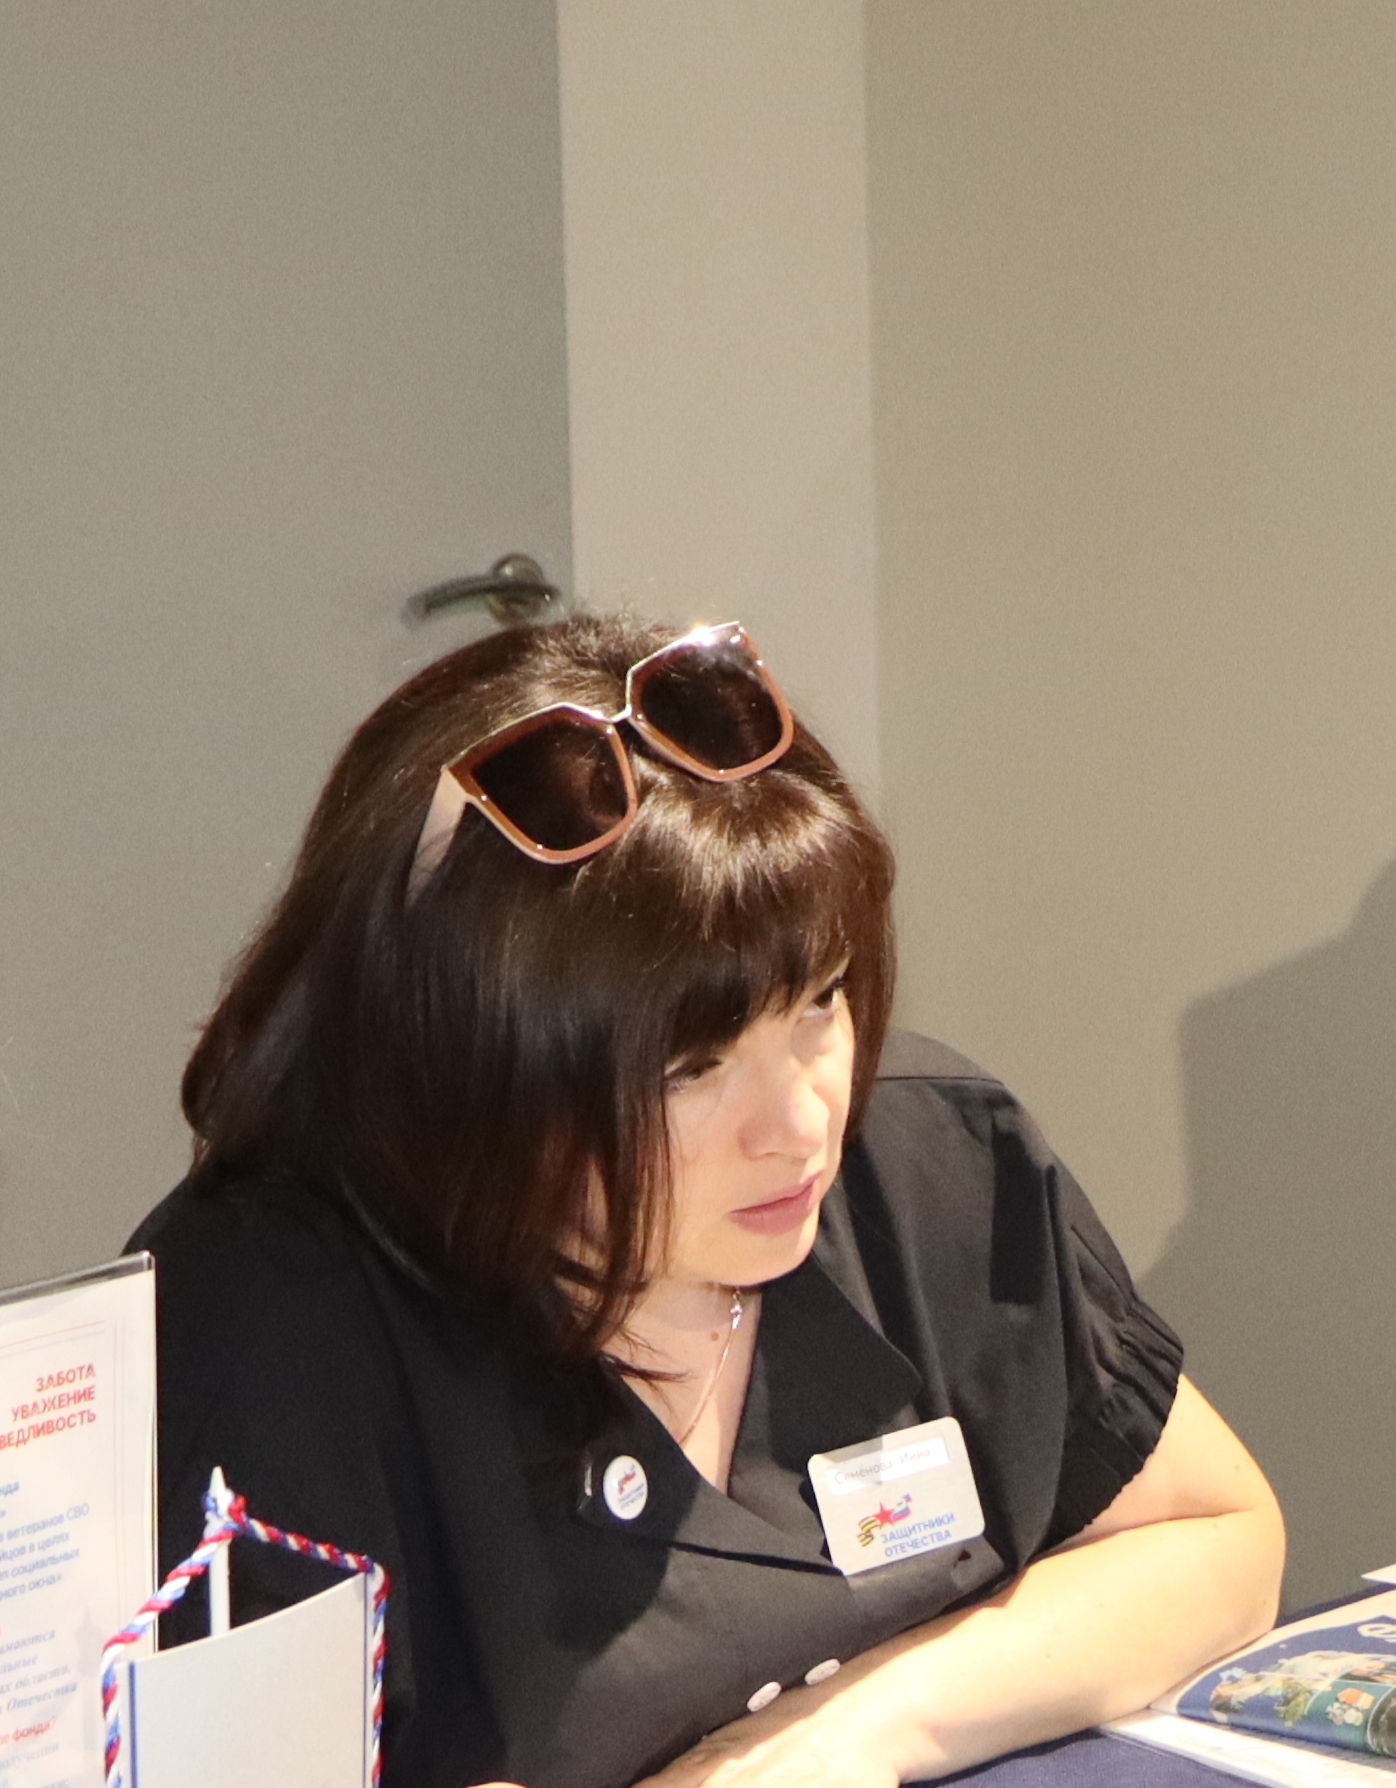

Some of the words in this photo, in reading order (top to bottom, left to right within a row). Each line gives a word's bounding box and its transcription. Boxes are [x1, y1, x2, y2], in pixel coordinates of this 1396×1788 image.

[35, 1363, 96, 1393] ЗАБОТА
[11, 1385, 96, 1422] УВАЖЕНИЕ
[7, 1513, 65, 1541] ветеранов
[66, 1502, 90, 1521] СВО
[880, 1513, 955, 1544] ЗАЩИТНИКИ
[884, 1530, 951, 1557] ОТЕЧЕСТВА
[11, 1548, 80, 1578] социальных
